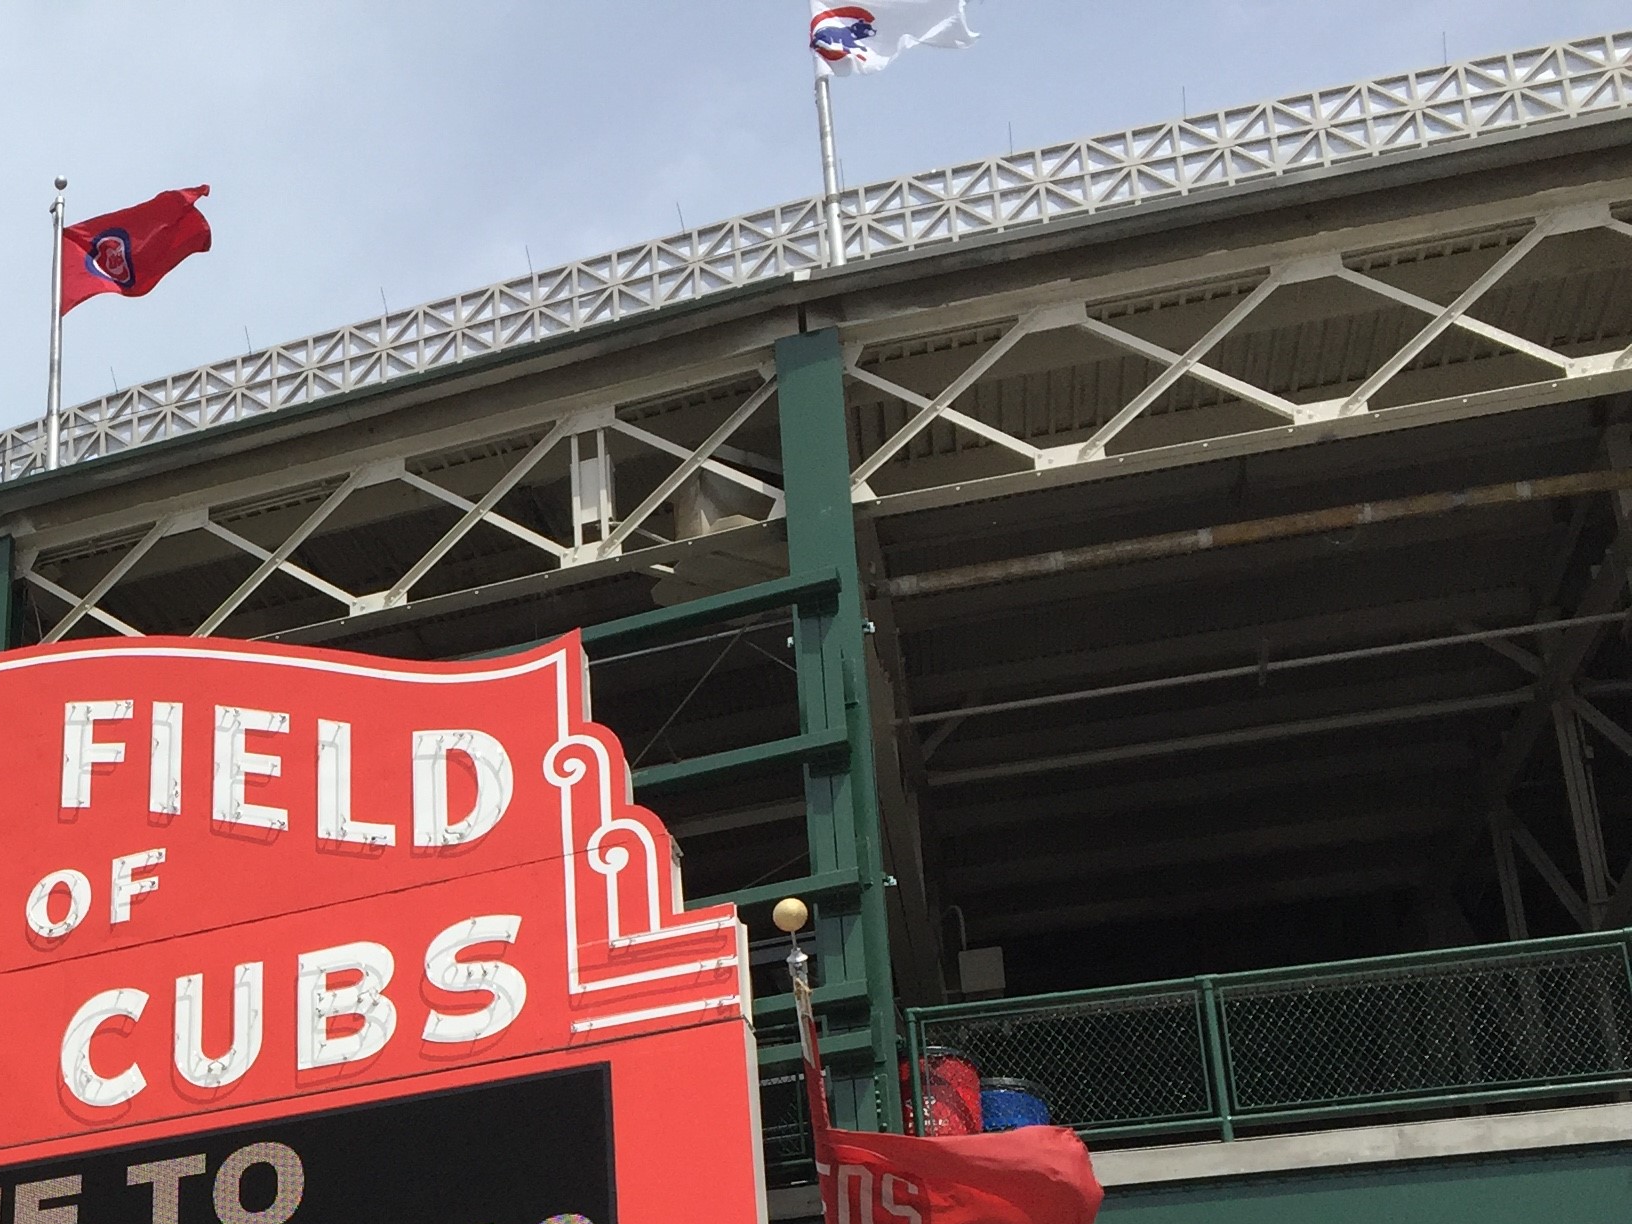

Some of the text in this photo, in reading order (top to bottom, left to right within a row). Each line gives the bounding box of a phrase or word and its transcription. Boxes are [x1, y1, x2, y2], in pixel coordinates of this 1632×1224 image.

[60, 699, 514, 848] FIELD
[25, 847, 167, 938] OF
[60, 914, 528, 1107] CUBS
